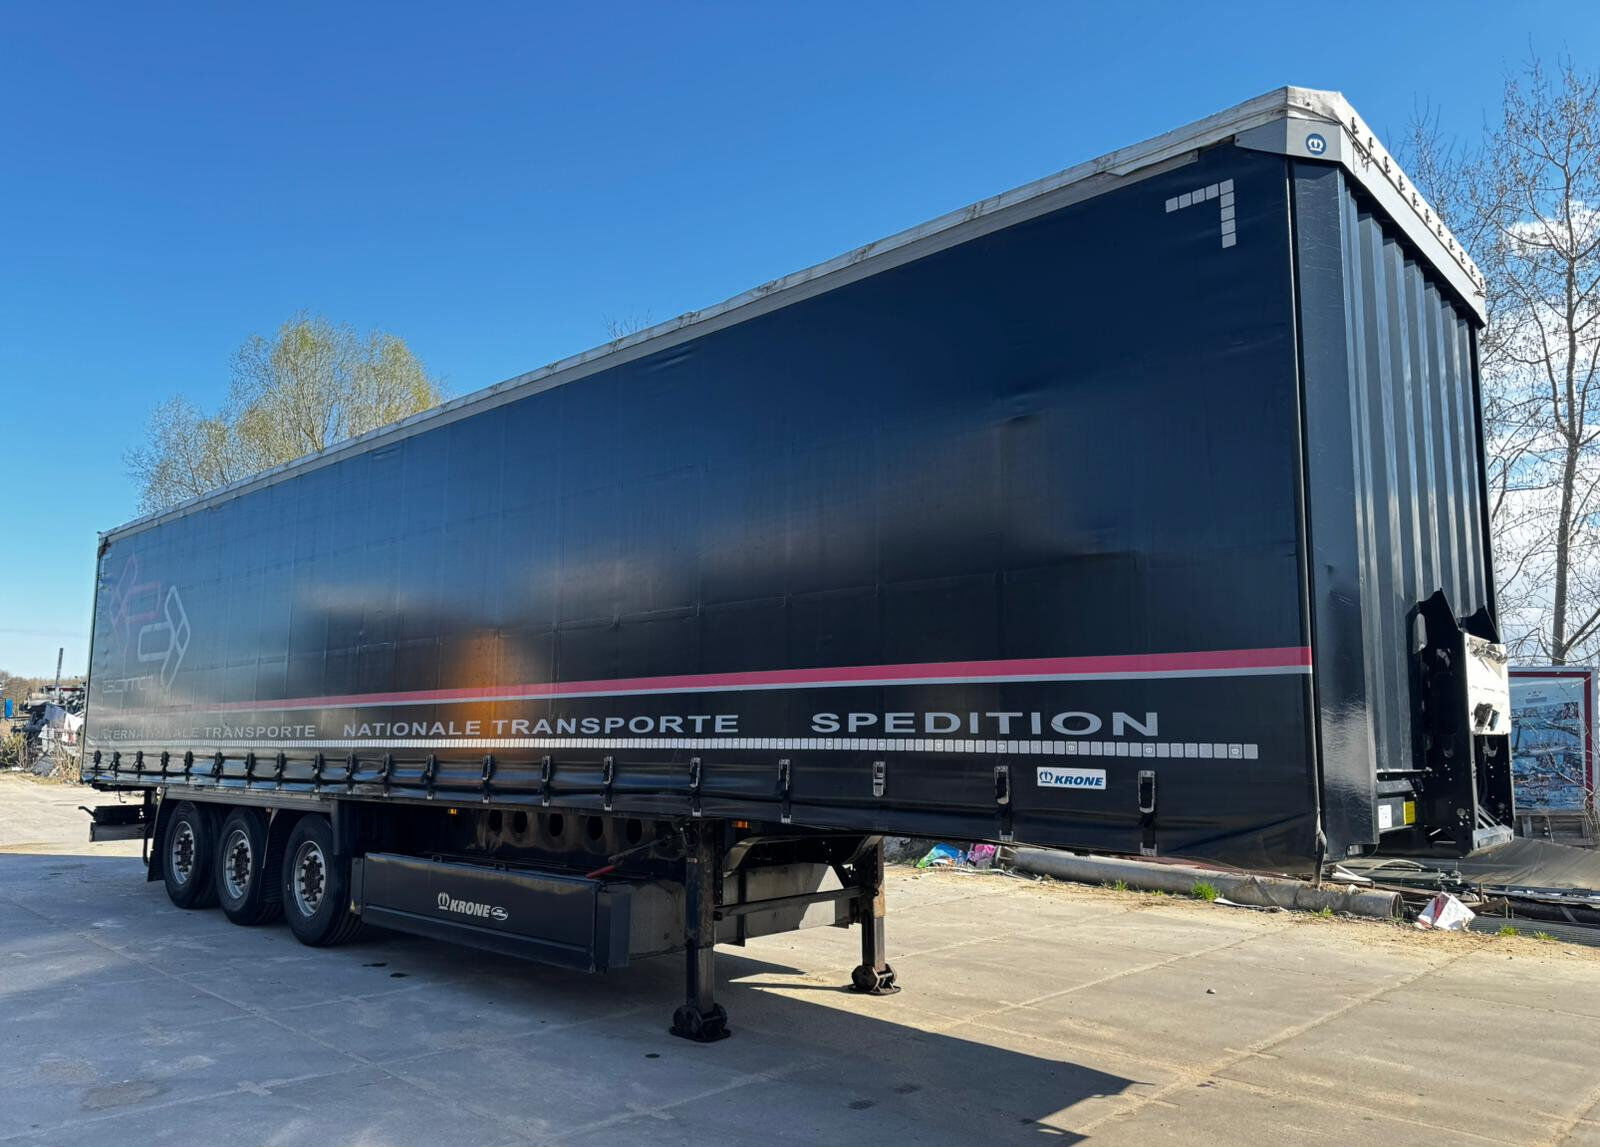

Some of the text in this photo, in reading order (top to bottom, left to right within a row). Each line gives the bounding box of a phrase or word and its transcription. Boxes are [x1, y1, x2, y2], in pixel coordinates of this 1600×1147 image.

[204, 724, 316, 738] TRANSPORTE
[343, 720, 481, 737] NATIONALE
[492, 714, 740, 735] TRANSPORTE
[810, 711, 1160, 737] SPEDITION
[1055, 775, 1104, 786] KRONE
[449, 899, 491, 918] KRONE
